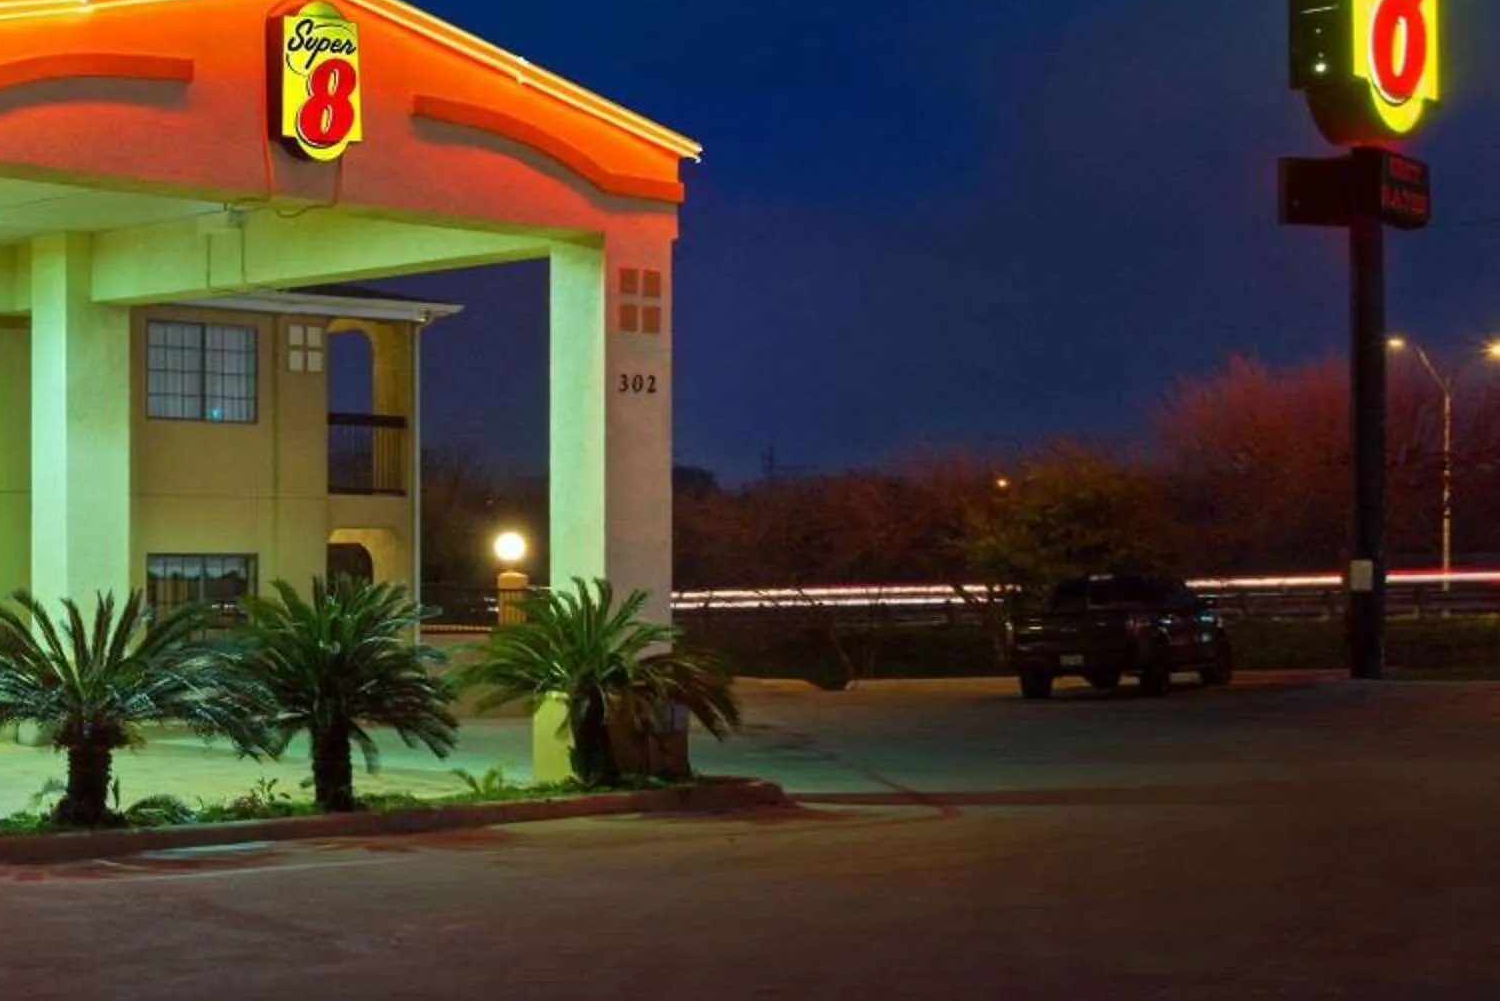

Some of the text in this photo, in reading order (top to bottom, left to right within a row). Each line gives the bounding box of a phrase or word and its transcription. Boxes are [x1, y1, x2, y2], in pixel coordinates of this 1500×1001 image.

[287, 19, 357, 70] Super
[296, 58, 357, 147] 8
[618, 374, 657, 394] 302
